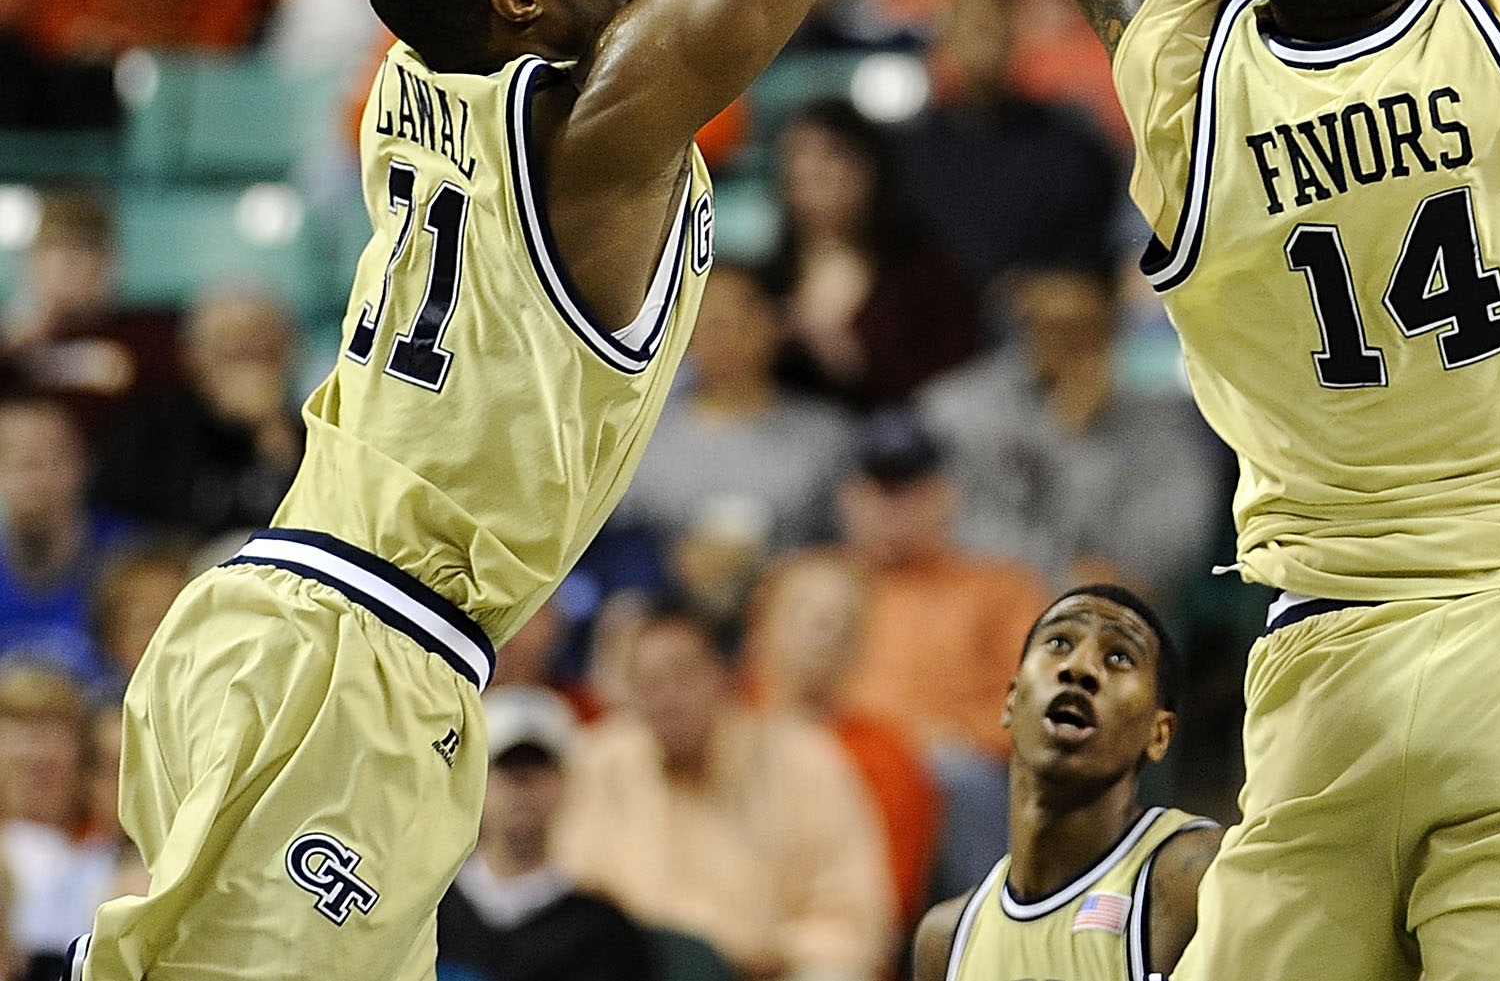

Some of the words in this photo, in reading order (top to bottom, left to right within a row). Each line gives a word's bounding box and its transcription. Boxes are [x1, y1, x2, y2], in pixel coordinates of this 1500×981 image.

[376, 54, 476, 180] LAWAL
[1246, 86, 1474, 215] FAVORS
[285, 832, 381, 927] GT
